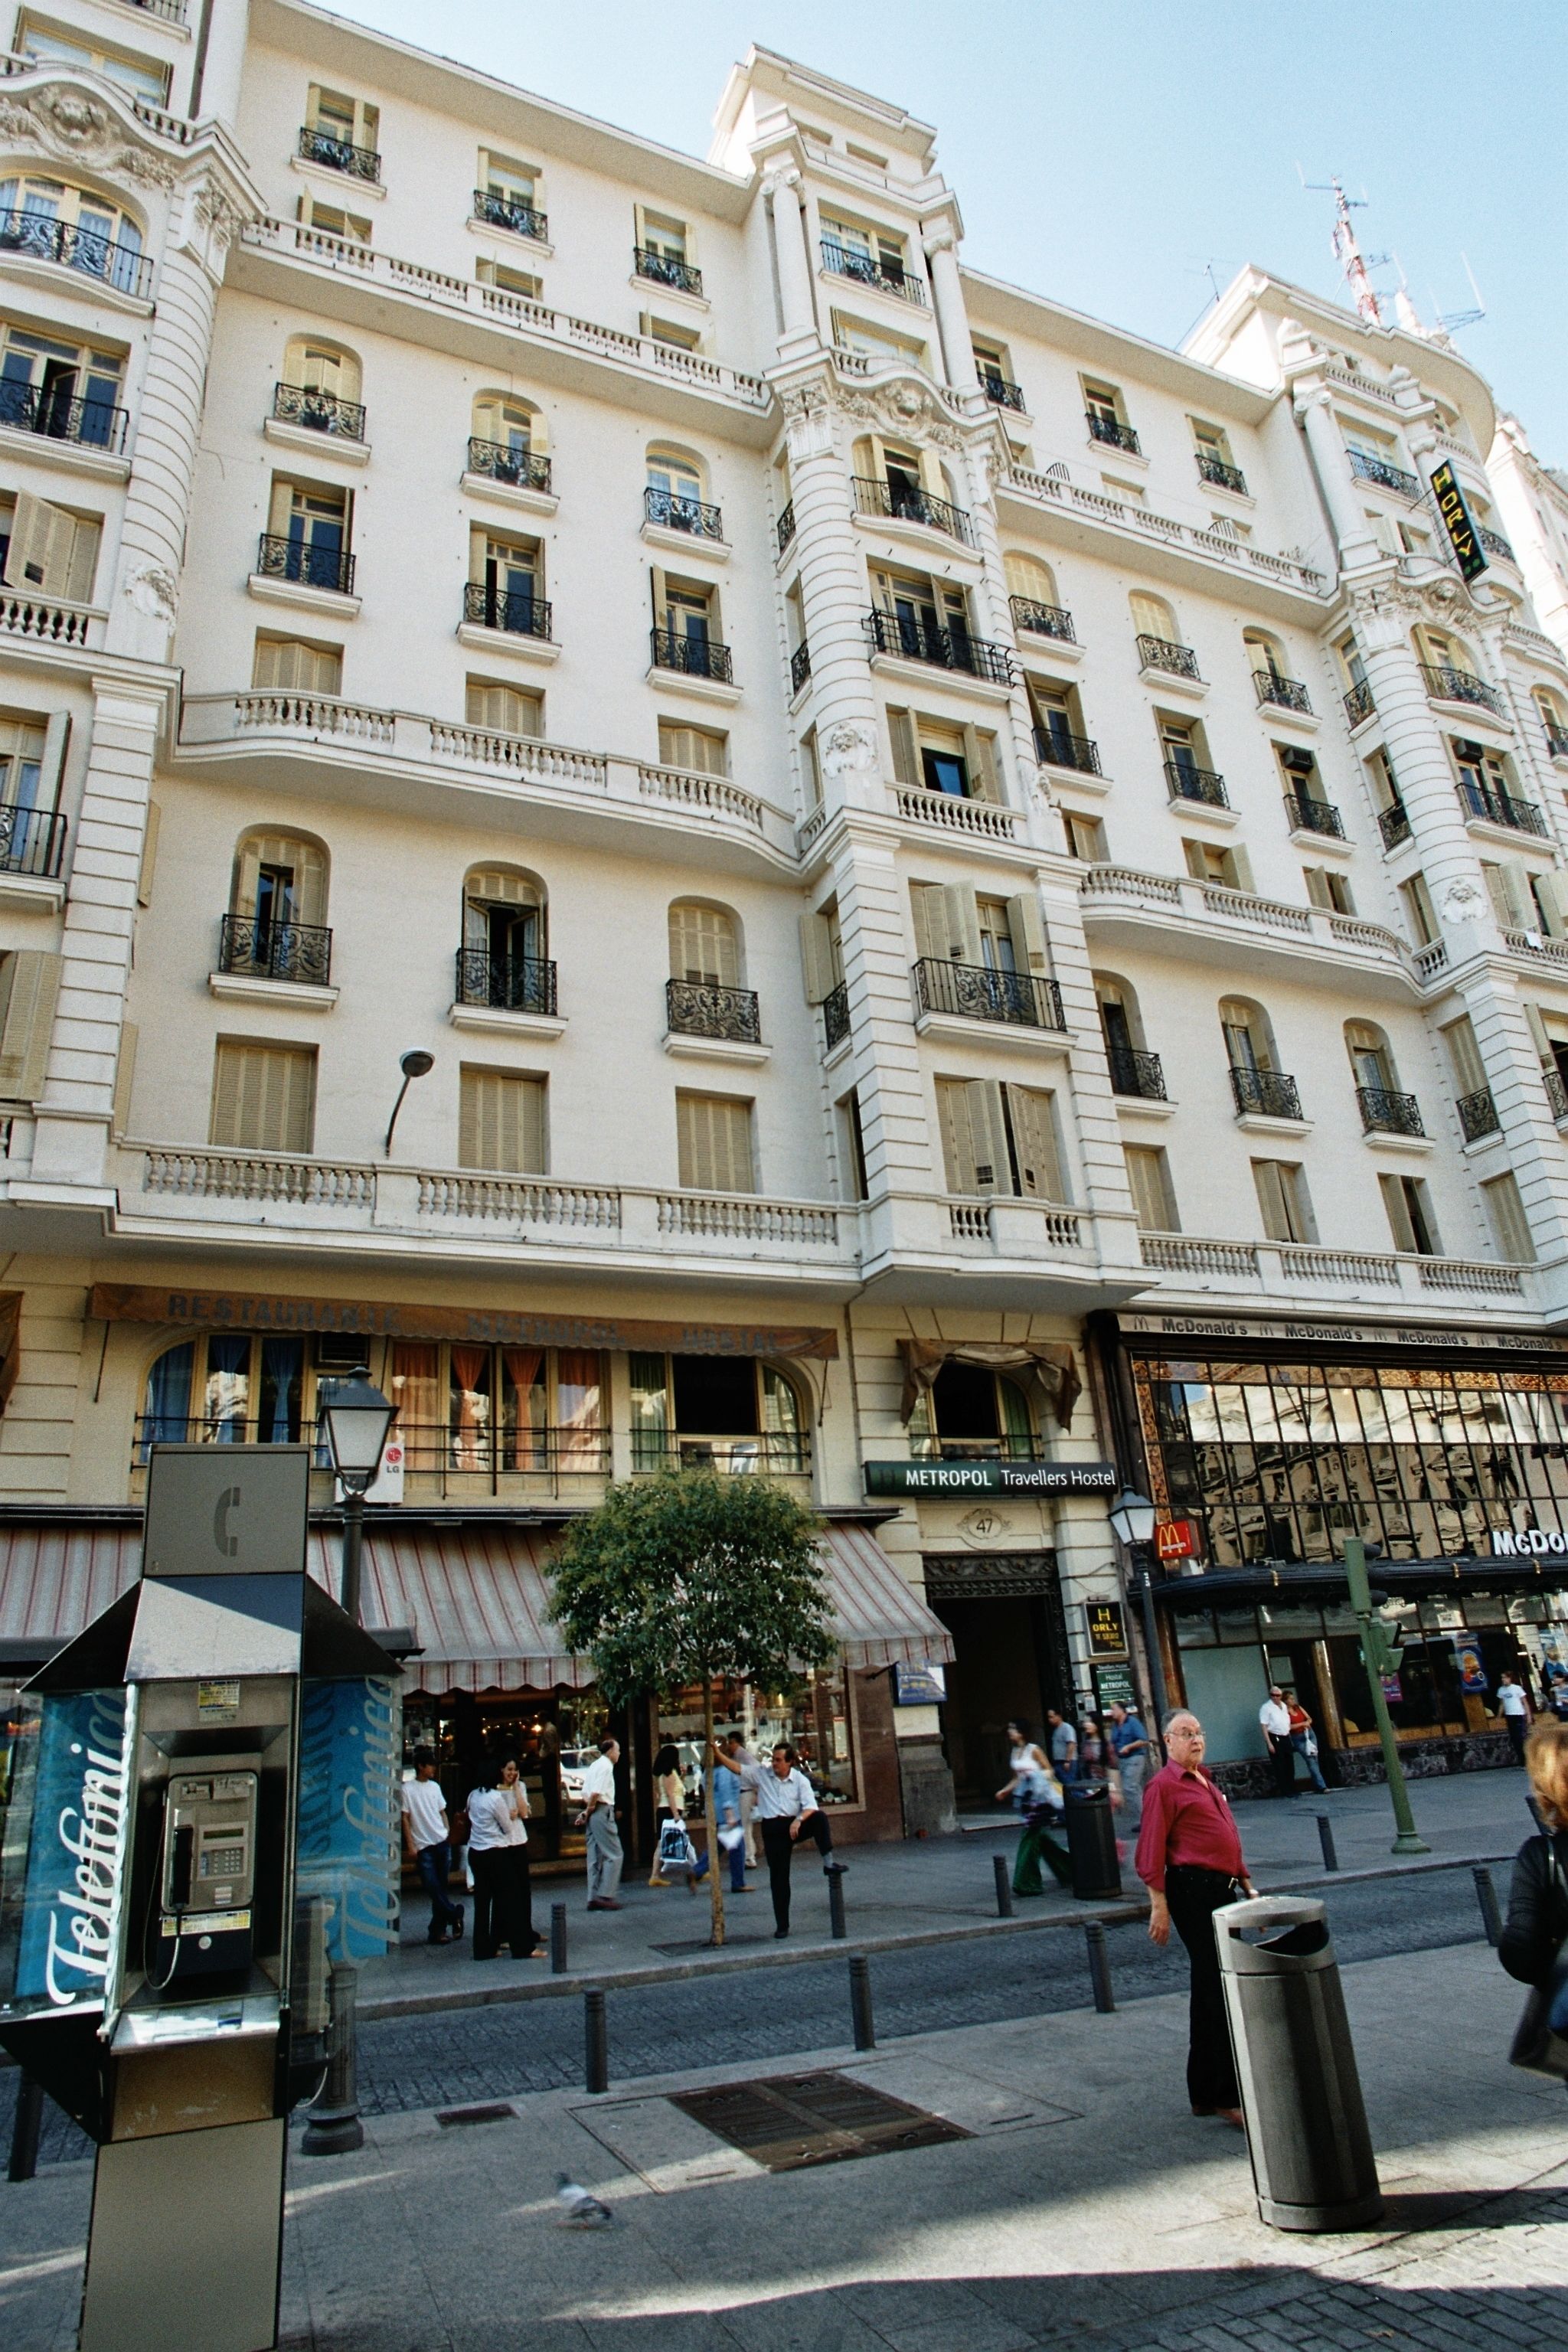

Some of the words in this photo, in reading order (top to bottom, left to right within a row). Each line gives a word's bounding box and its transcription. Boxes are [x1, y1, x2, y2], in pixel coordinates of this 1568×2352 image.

[1441, 492, 1473, 557] ORLY
[168, 1293, 402, 1333] RESTAURANTE
[1161, 1317, 1248, 1336] McDonald's
[1285, 1324, 1364, 1341] McDonald's
[1397, 1328, 1468, 1346] McDonald's
[1497, 1334, 1563, 1351] McDonald's
[387, 1465, 400, 1474] LG
[906, 1469, 992, 1487] METROPOL
[1001, 1469, 1067, 1486] Travellers
[1071, 1469, 1116, 1486] Hostel
[976, 1518, 993, 1534] 47
[1492, 1530, 1568, 1555] McDo
[1092, 1622, 1119, 1632] ORLY
[1100, 1681, 1131, 1689] METROPOL
